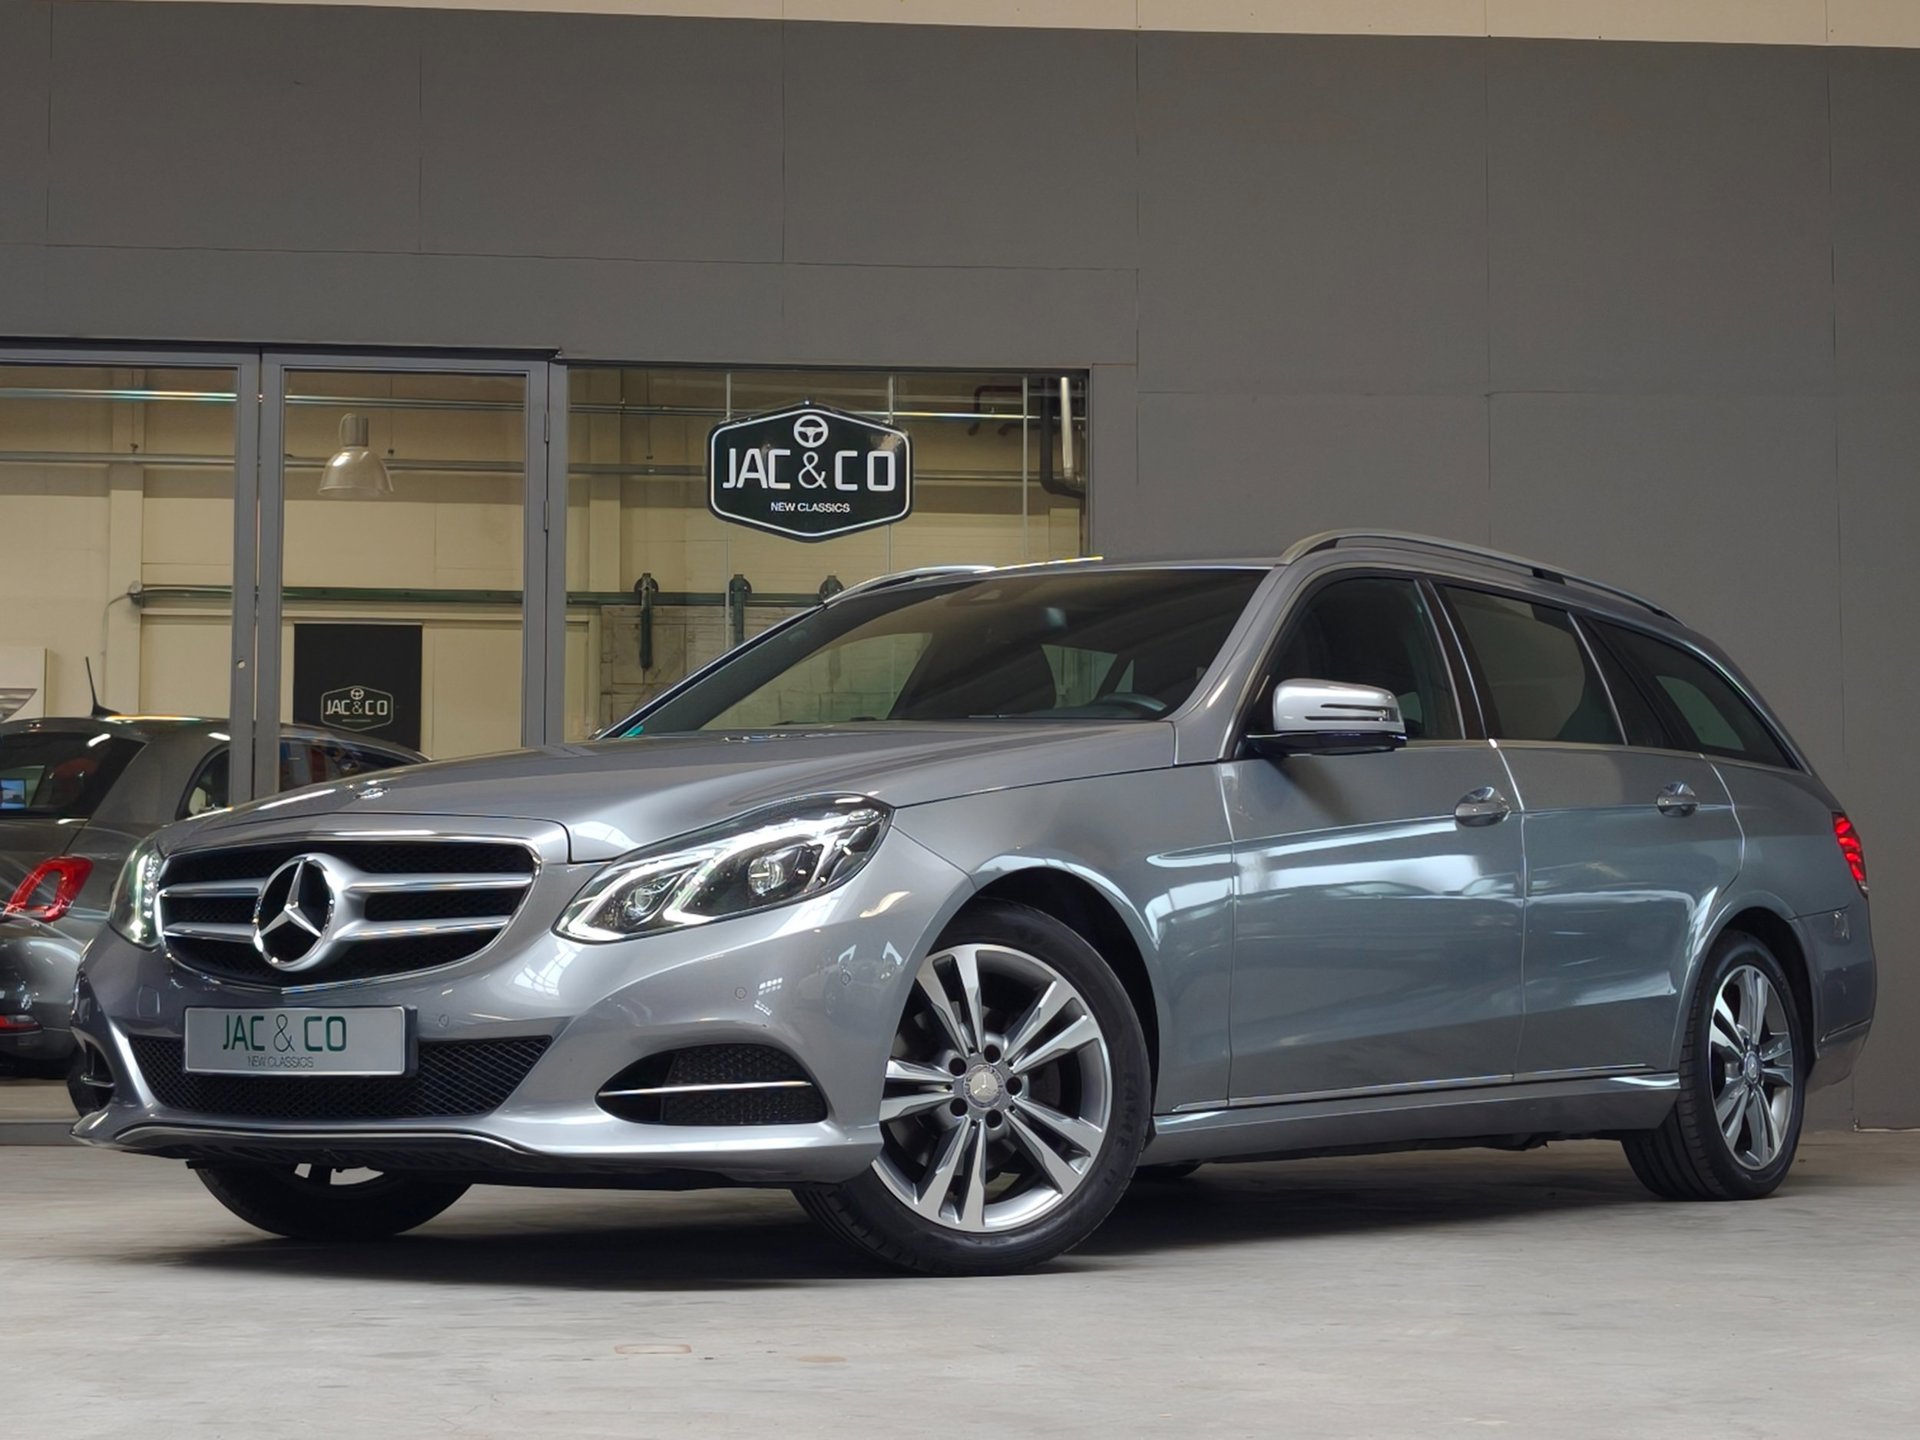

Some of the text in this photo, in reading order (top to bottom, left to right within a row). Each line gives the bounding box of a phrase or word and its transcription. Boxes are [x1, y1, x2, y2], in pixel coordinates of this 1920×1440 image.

[770, 501, 850, 513] NEW CLASSICS
[222, 1013, 347, 1053] JAC & CO
[248, 1056, 314, 1069] NEW CLASSICS
